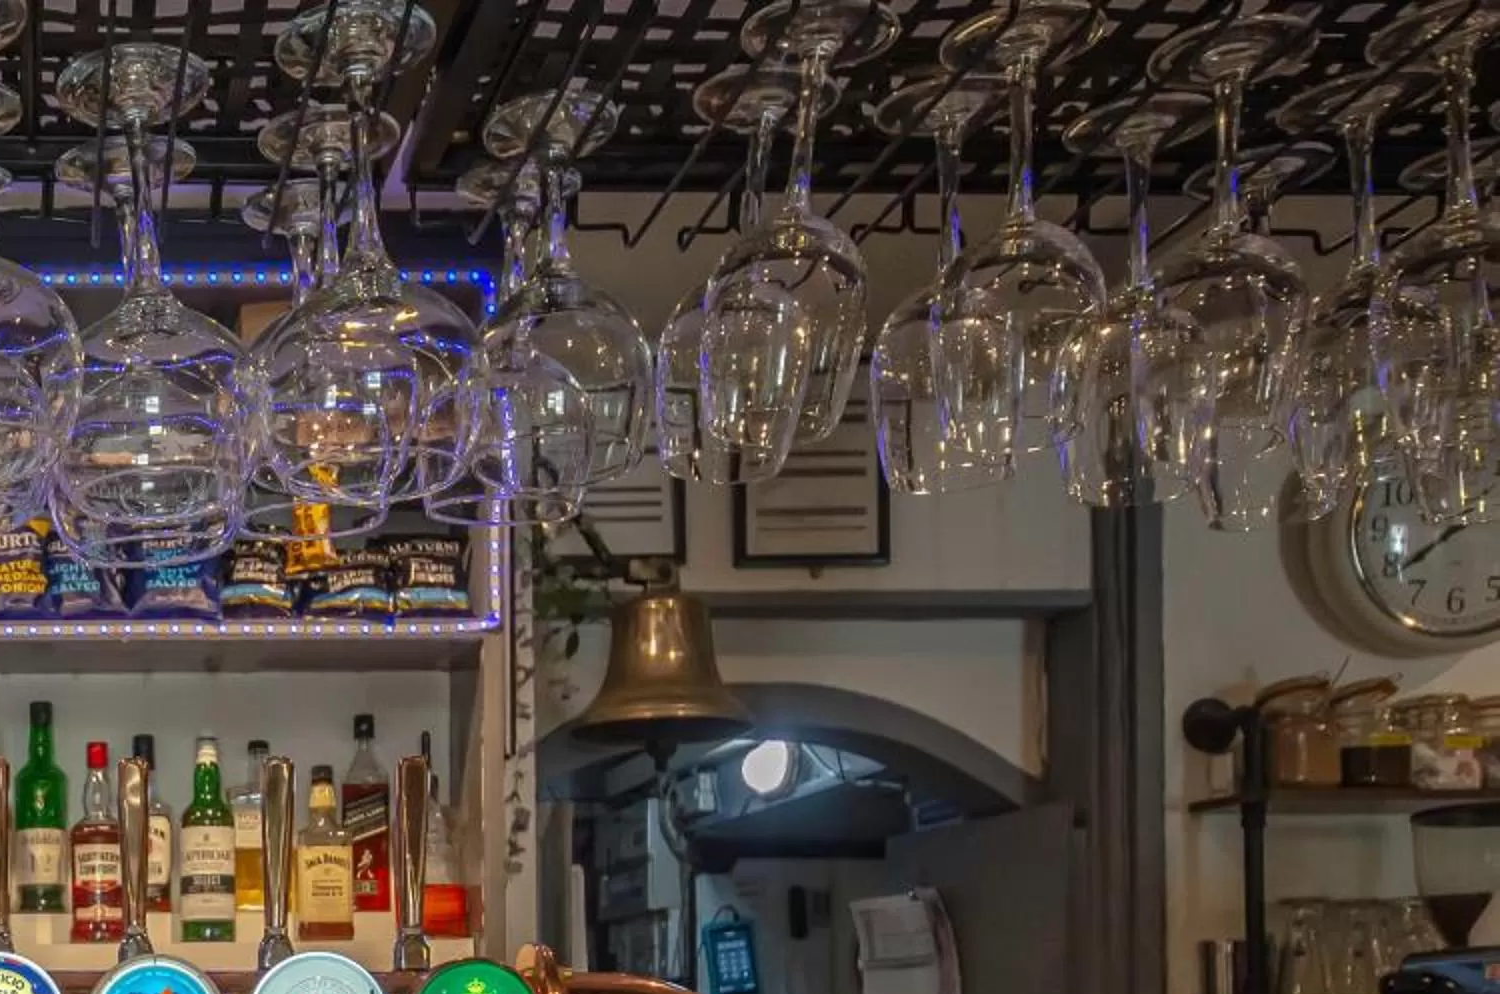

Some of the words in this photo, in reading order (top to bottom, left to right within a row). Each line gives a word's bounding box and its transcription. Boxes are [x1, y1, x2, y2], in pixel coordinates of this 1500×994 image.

[1381, 478, 1414, 507] 10
[1371, 514, 1389, 542] 9
[1383, 552, 1399, 577] 8
[1408, 579, 1427, 605] 7
[1446, 587, 1465, 614] 6
